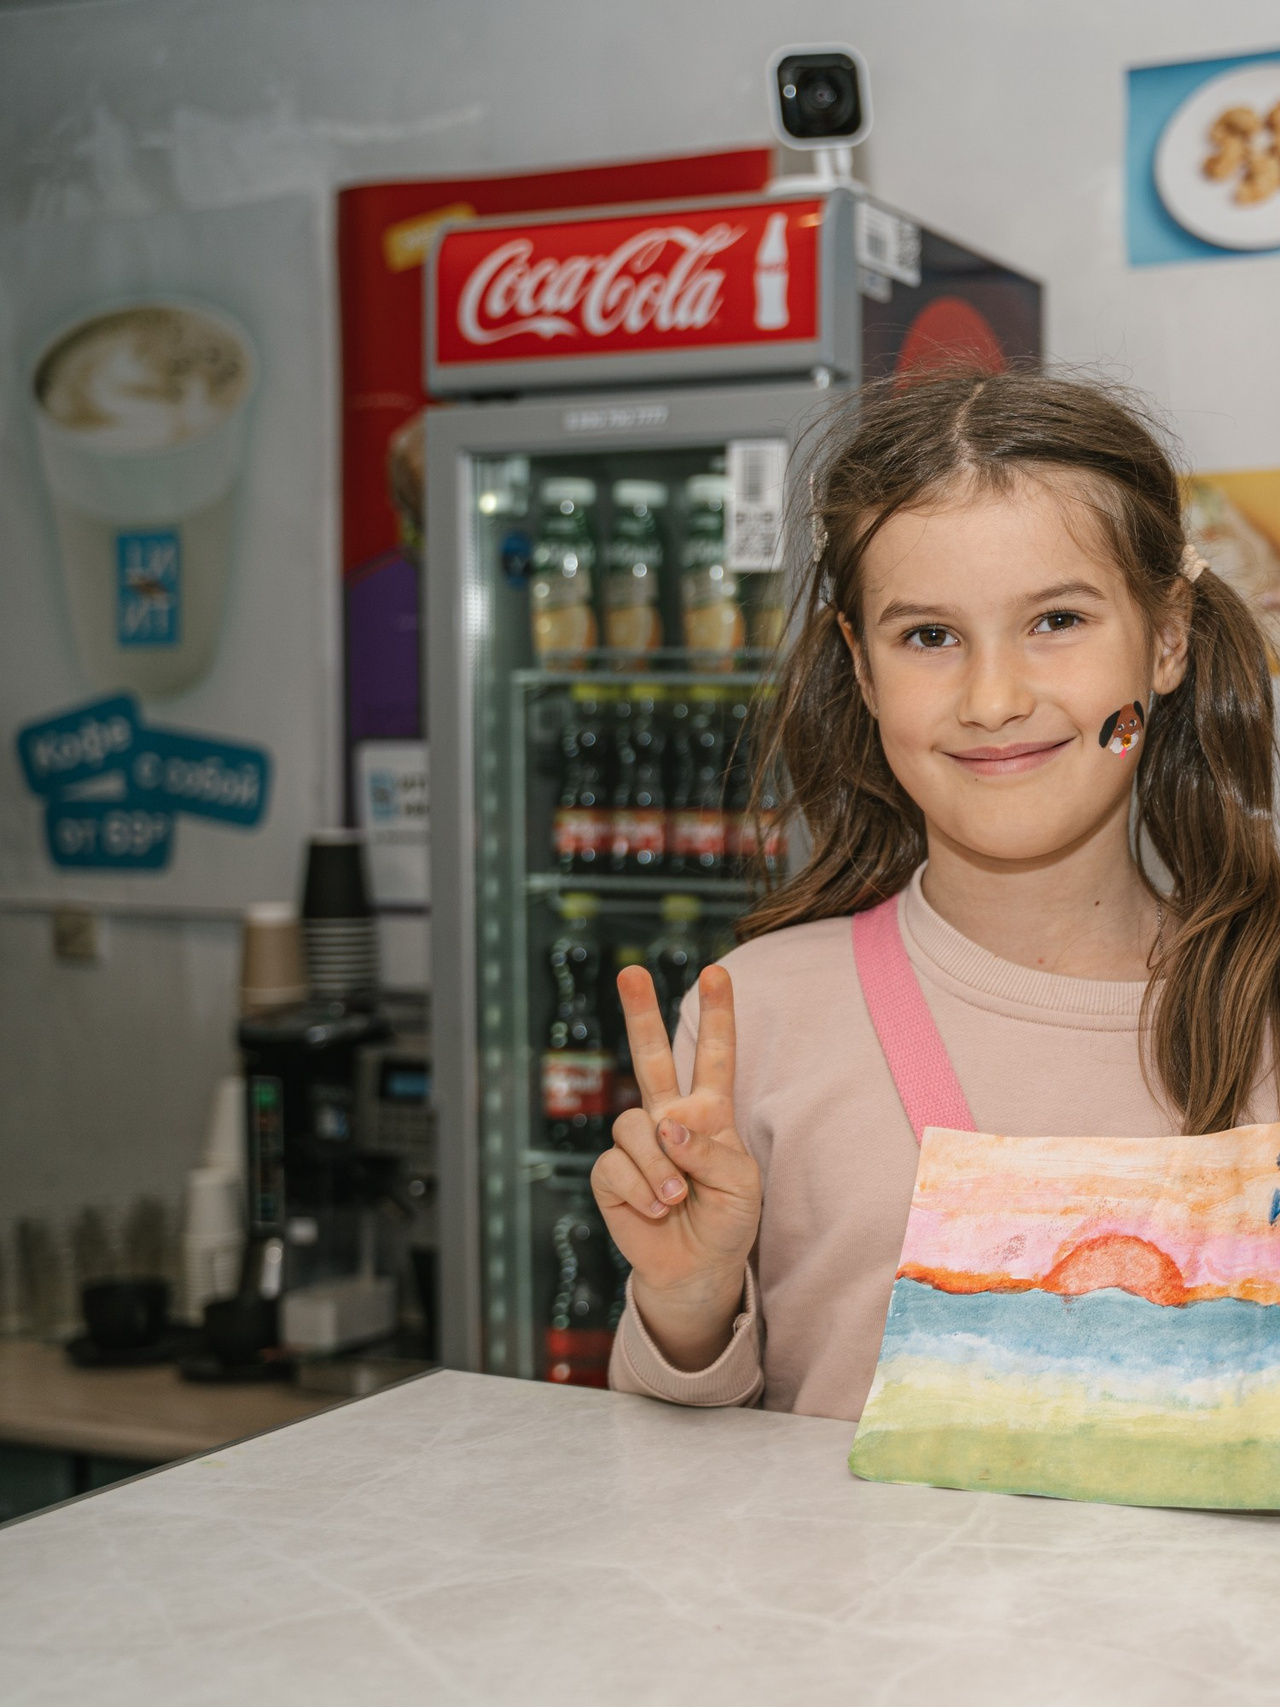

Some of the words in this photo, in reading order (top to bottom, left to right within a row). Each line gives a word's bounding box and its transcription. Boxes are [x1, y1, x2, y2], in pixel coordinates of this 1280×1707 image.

[457, 223, 748, 345] Coca-Cola
[33, 716, 133, 773] Кофе
[165, 756, 261, 808] собой
[58, 819, 97, 855] от
